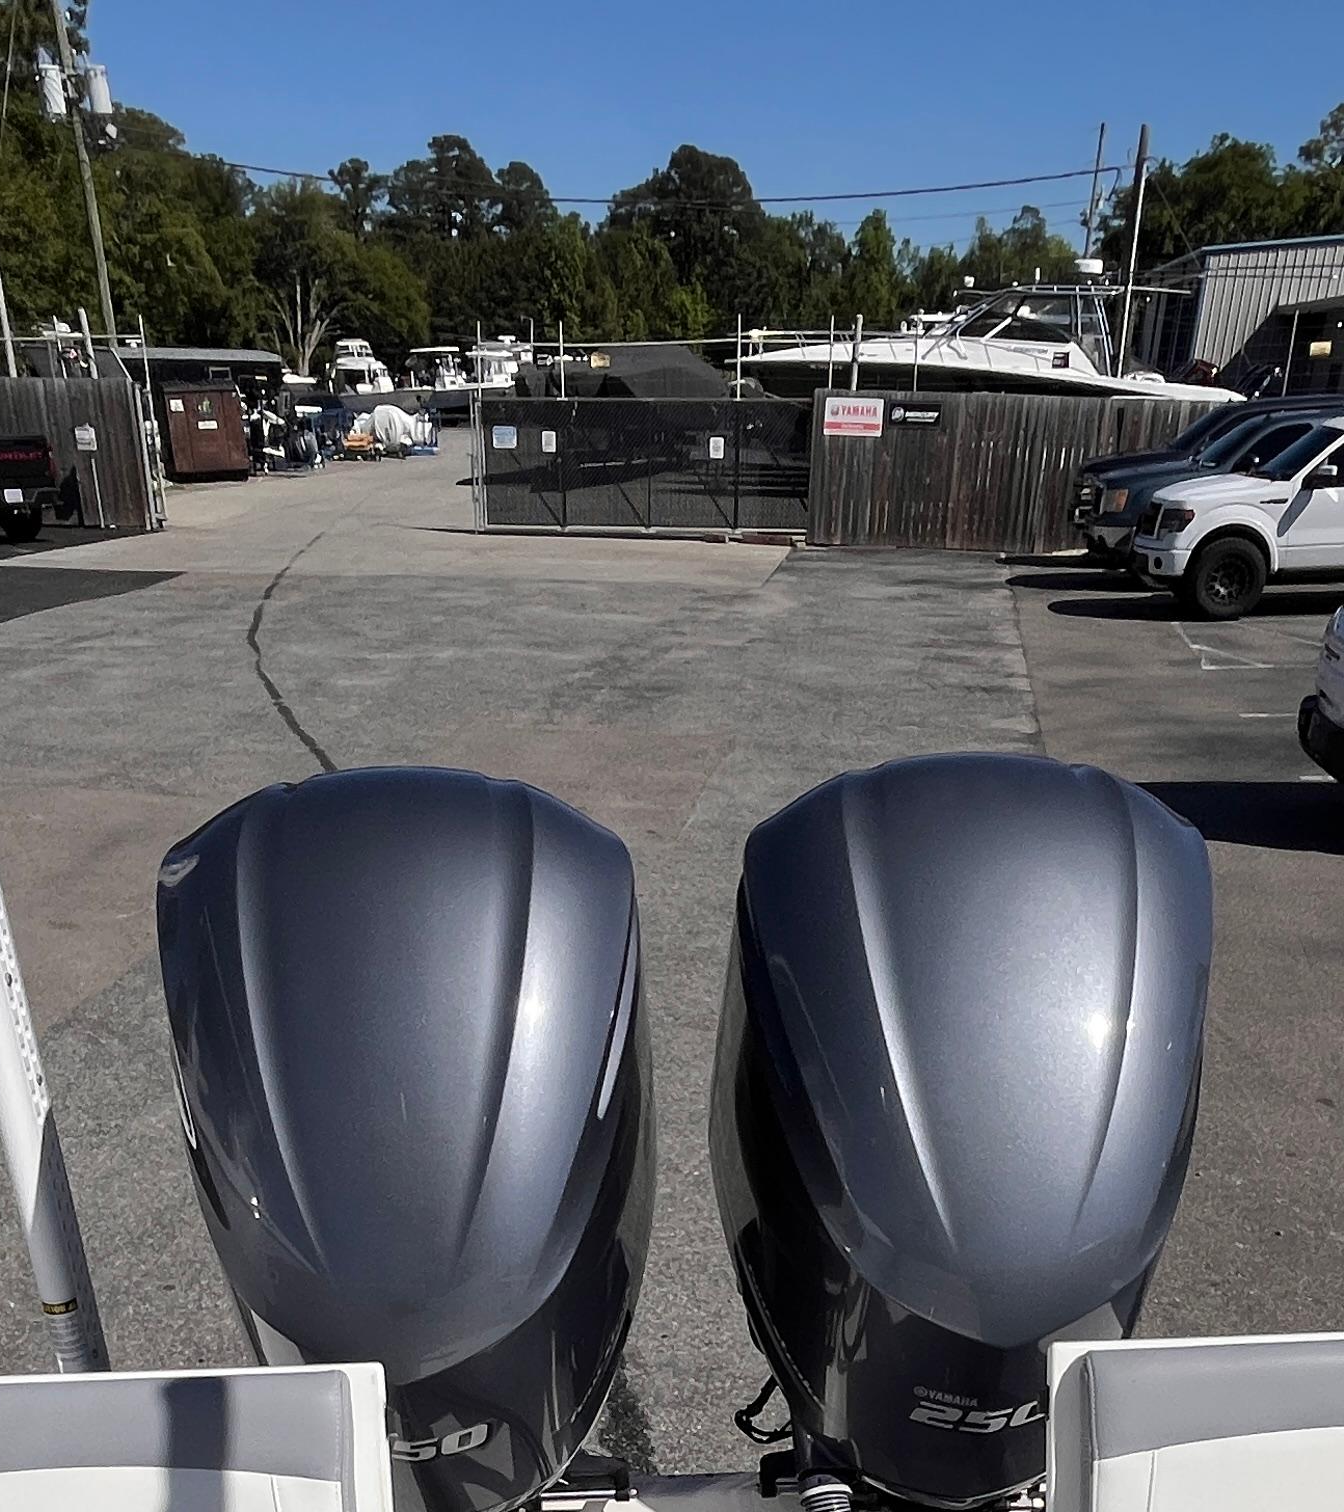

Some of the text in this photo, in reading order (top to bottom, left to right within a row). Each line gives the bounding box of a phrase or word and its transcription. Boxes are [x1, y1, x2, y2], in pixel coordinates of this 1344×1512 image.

[840, 404, 879, 418] YAMAHA
[928, 1389, 979, 1407] YAMAHA
[387, 1423, 488, 1461] 50
